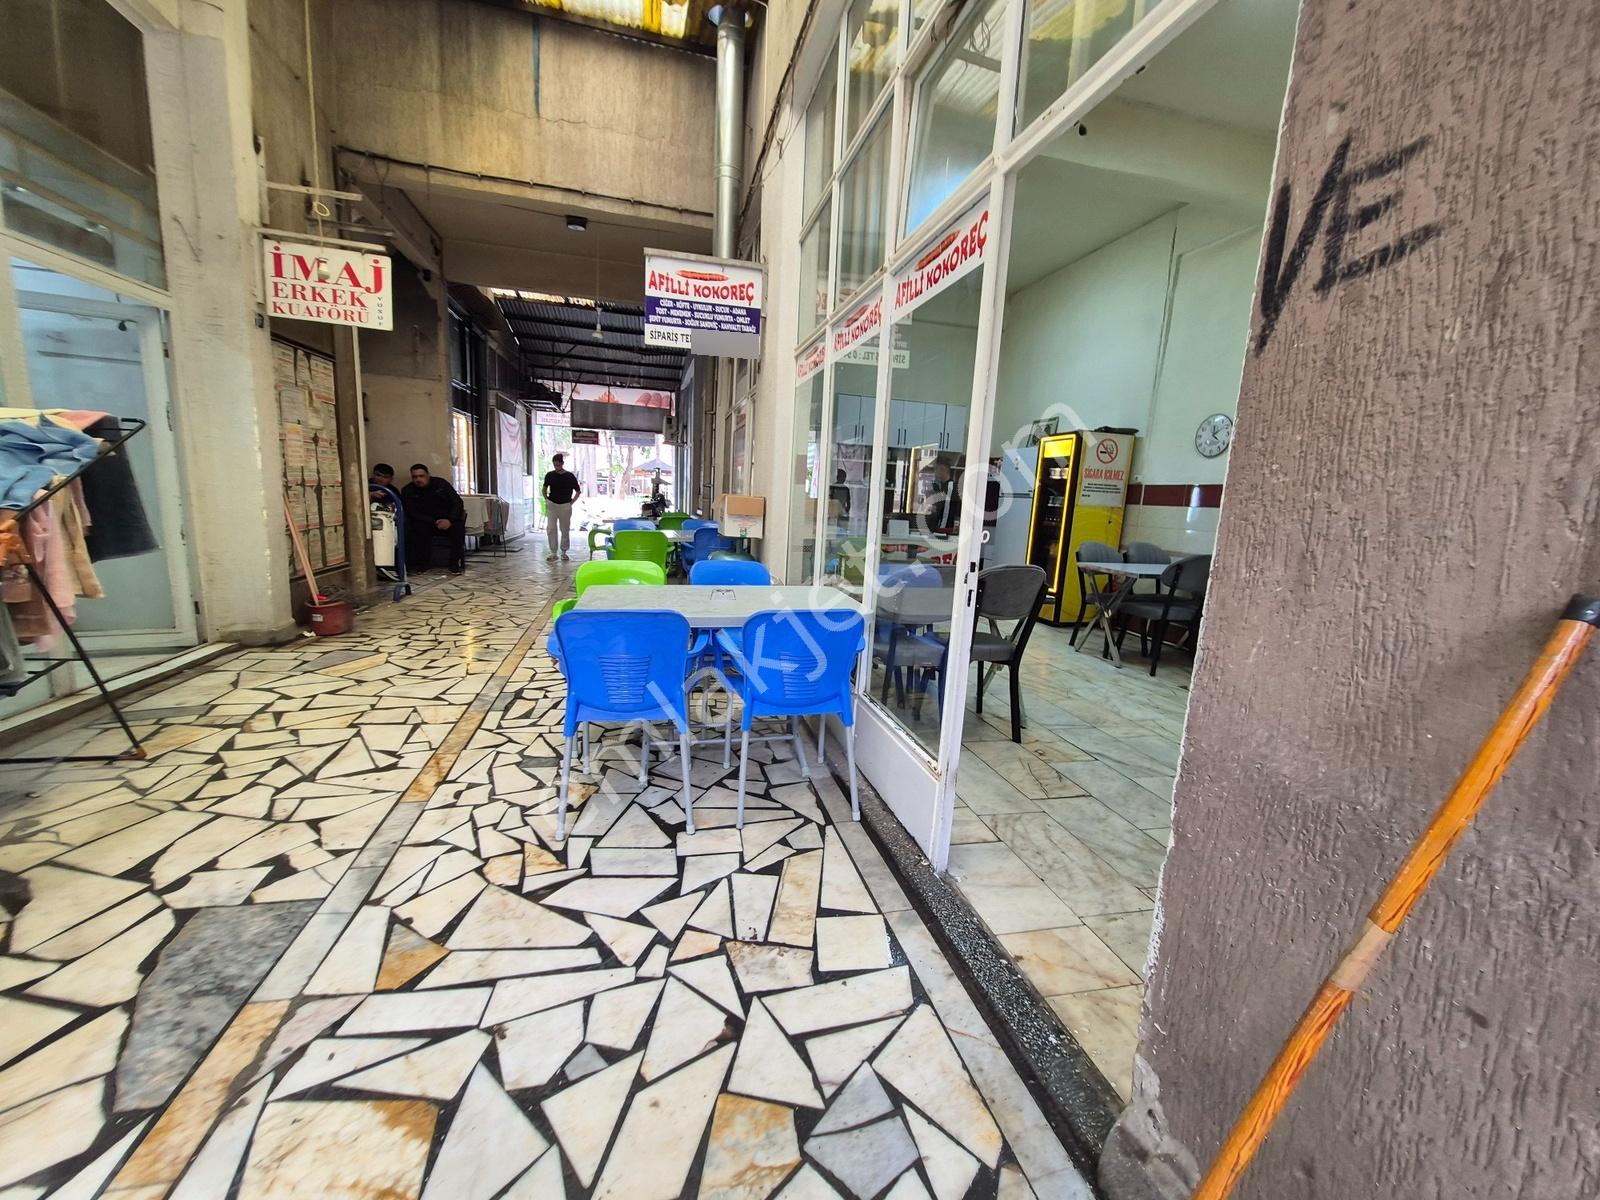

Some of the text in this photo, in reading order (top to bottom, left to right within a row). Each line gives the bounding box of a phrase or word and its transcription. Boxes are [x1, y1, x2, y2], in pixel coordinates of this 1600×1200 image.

[1255, 129, 1443, 357] VE
[895, 210, 989, 310] AFİLLİ KOKOREÇ
[271, 281, 368, 309] ERKEK
[648, 270, 755, 306] AFİLLİ KOKOREÇ
[271, 301, 370, 323] KUAFÖRÜ
[649, 328, 691, 345] SİPARİŞ TE
